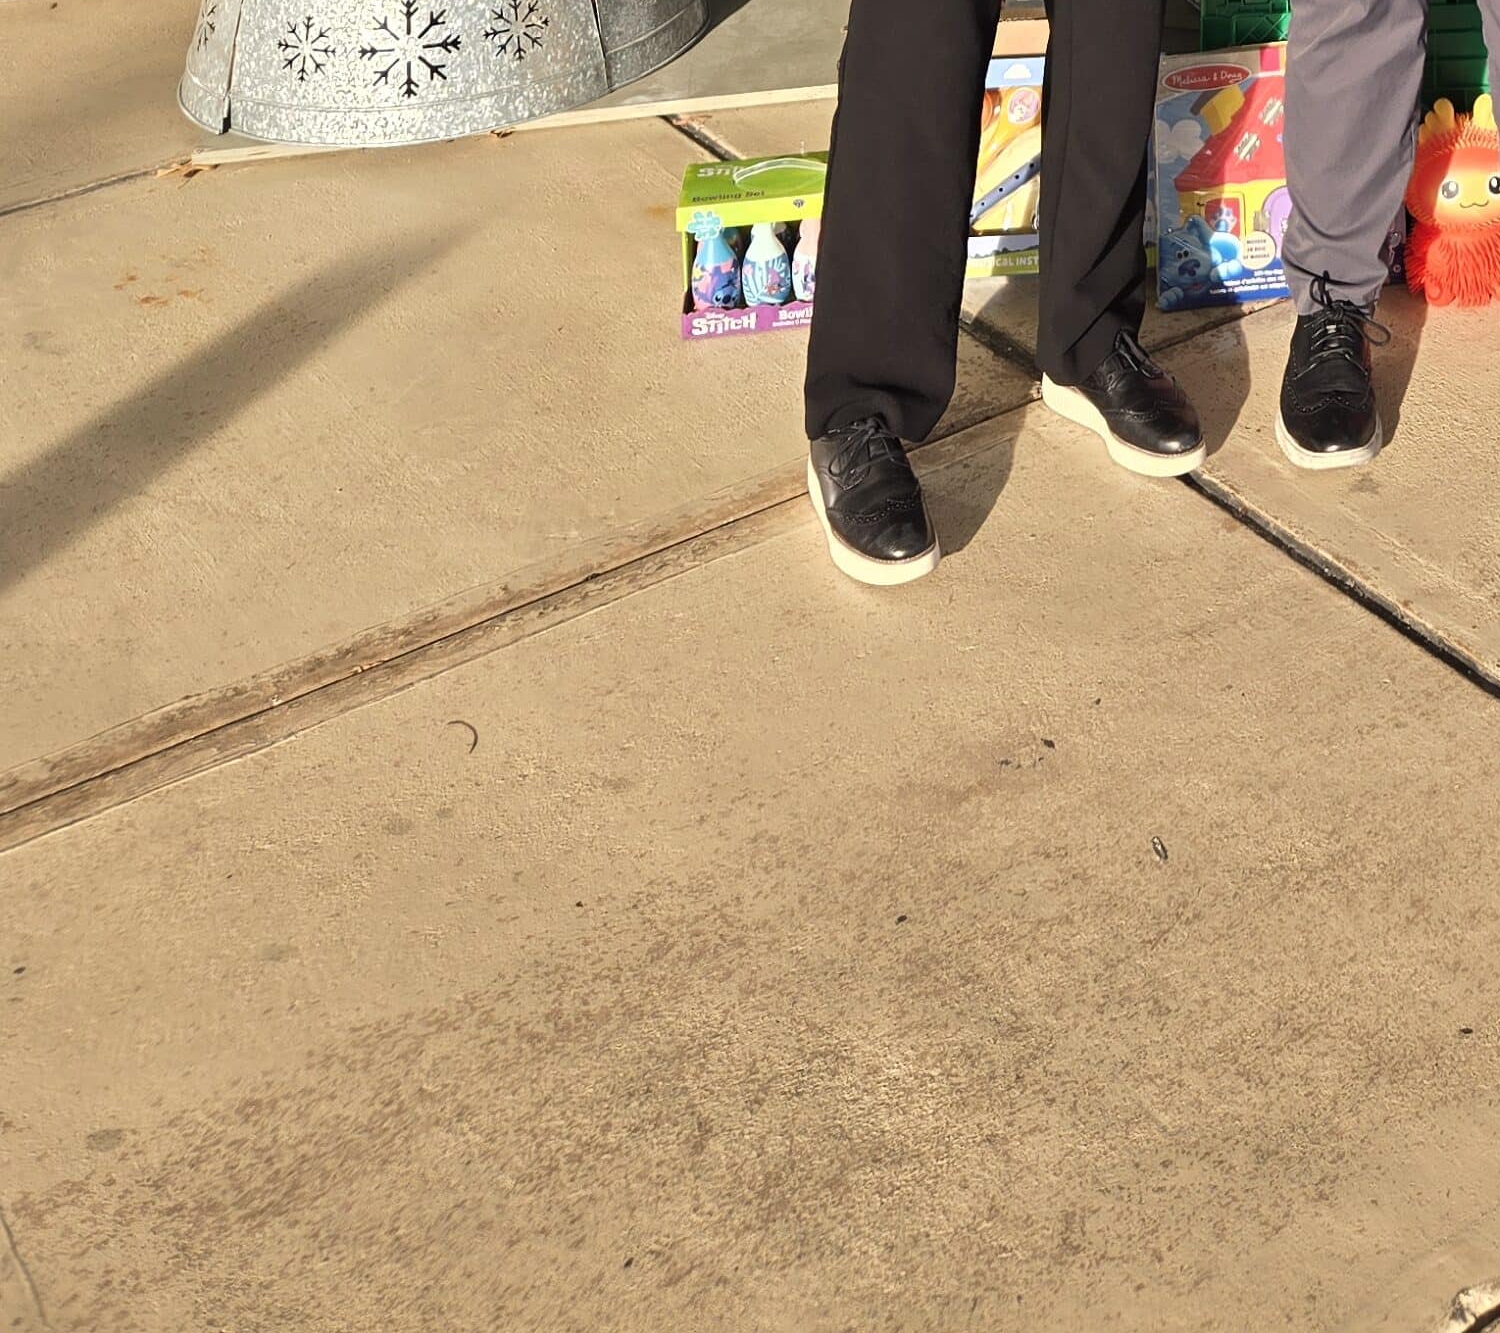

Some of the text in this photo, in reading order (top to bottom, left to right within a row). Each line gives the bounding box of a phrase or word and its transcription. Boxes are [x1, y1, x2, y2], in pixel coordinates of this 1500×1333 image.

[1172, 74, 1211, 86] Melissa
[1220, 70, 1243, 84] Doug
[1016, 256, 1038, 266] INST
[778, 306, 813, 320] Bowli
